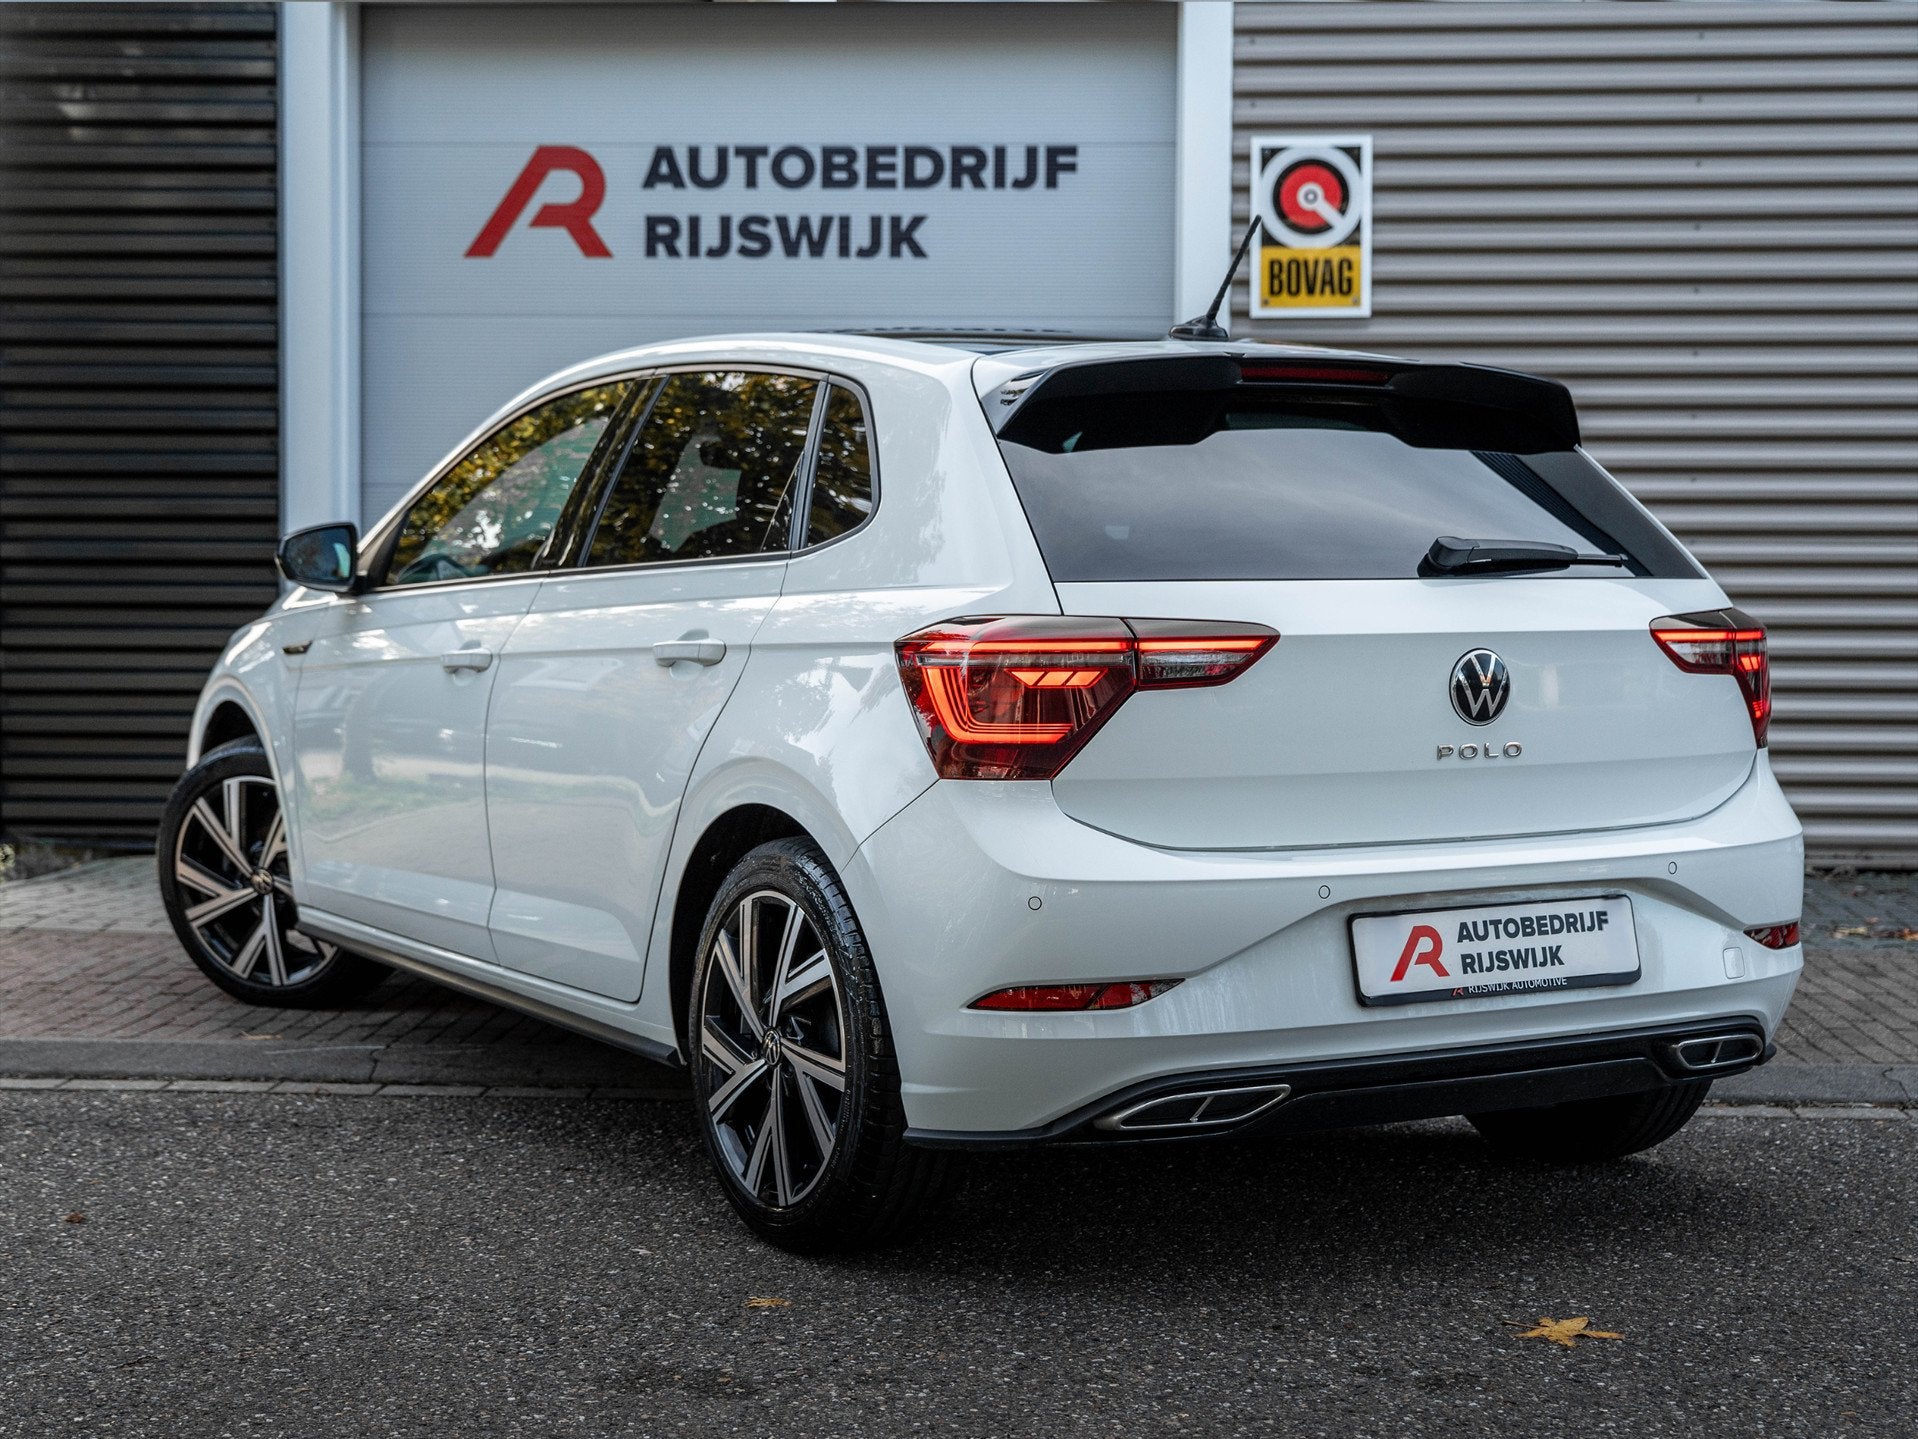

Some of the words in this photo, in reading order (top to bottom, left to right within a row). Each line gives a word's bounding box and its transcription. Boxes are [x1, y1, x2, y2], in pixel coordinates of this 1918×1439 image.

[642, 145, 1078, 190] AUTOBEDRIJF
[645, 215, 929, 258] RIJSWIJK
[1269, 258, 1354, 297] BOVAG
[1437, 741, 1522, 761] POLO
[1457, 911, 1609, 943] AUTOBEDRIJF
[1461, 945, 1565, 975] RIJSWIJK
[1468, 982, 1510, 994] RIJSWIJK
[1511, 977, 1568, 990] AUTOMOTIVE
